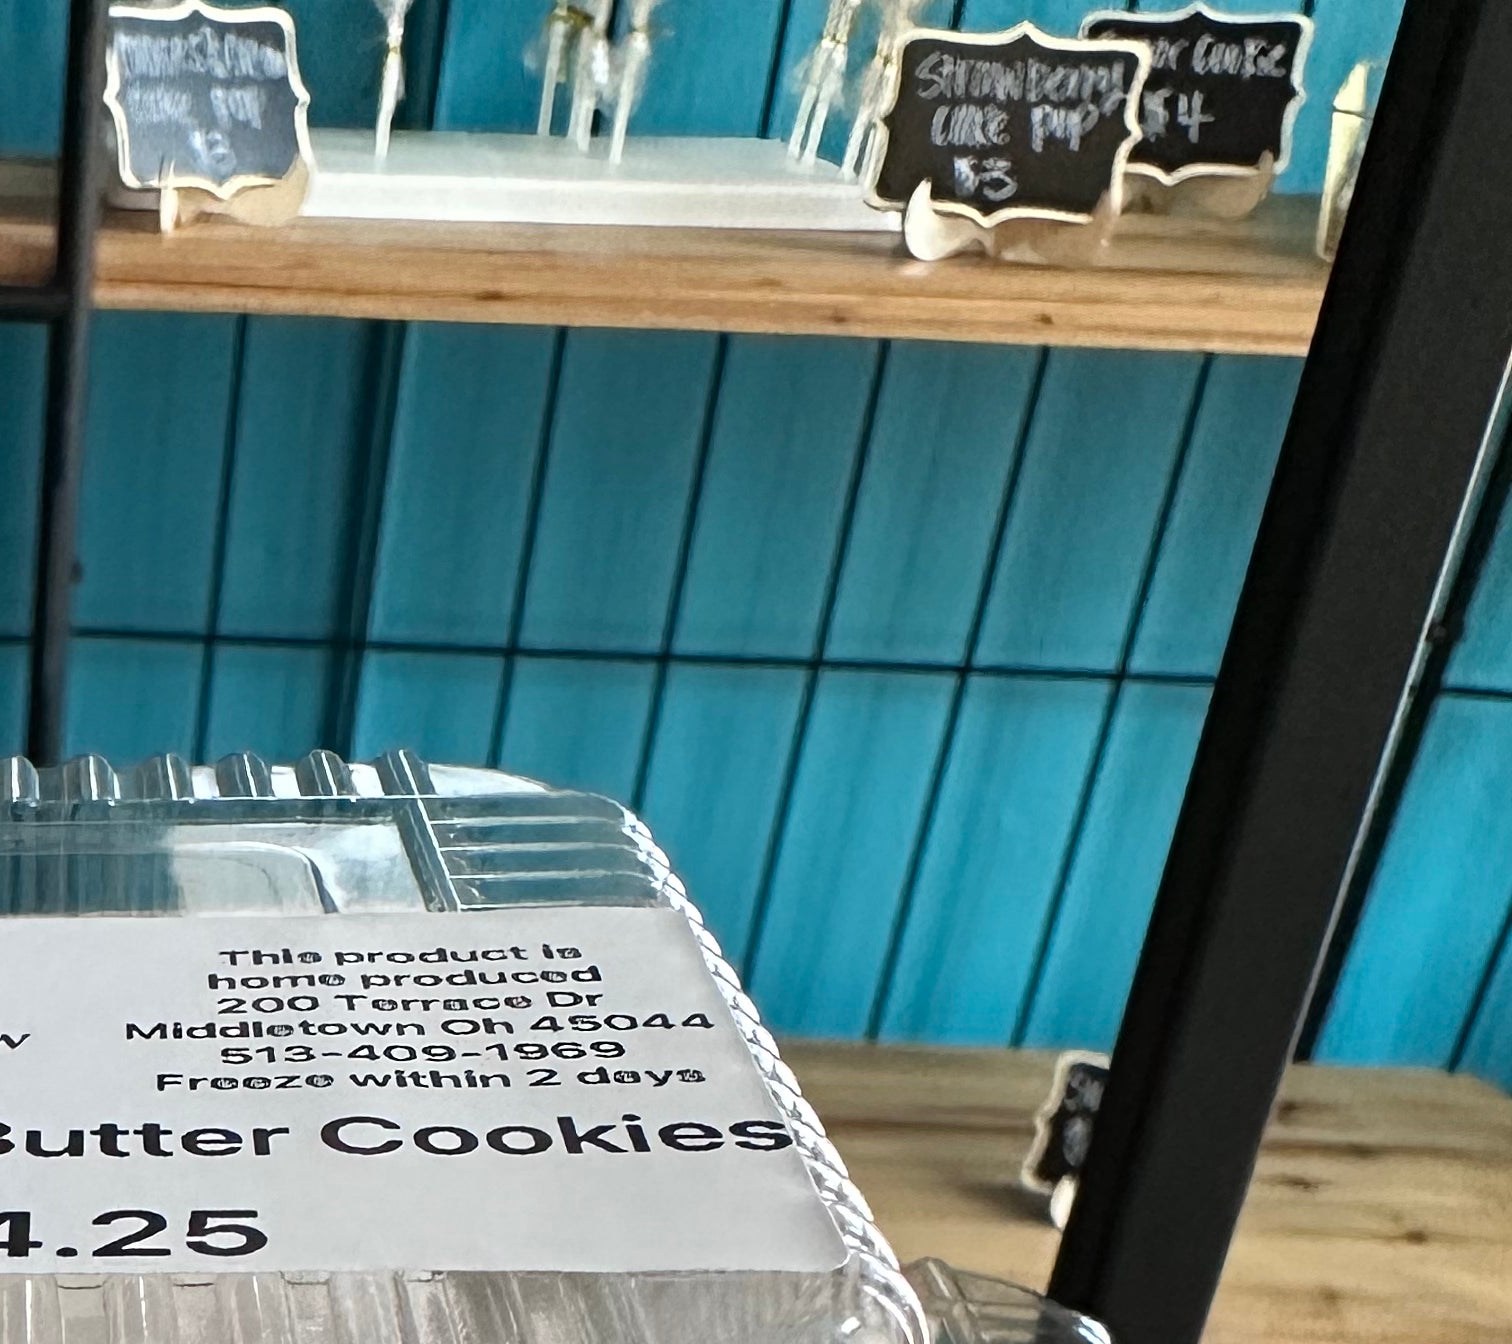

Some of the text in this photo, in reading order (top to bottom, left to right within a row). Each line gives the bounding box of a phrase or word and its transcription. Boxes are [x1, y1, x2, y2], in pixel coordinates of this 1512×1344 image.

[218, 943, 582, 966] This product is
[207, 965, 602, 990] home produced
[217, 991, 604, 1015] 200 Terrace Dr
[126, 1013, 715, 1040] Middletown Oh 45044
[220, 1041, 626, 1065] 513-409-1969
[156, 1066, 706, 1092] Freeze within 2 days
[320, 1113, 794, 1156] Cookies
